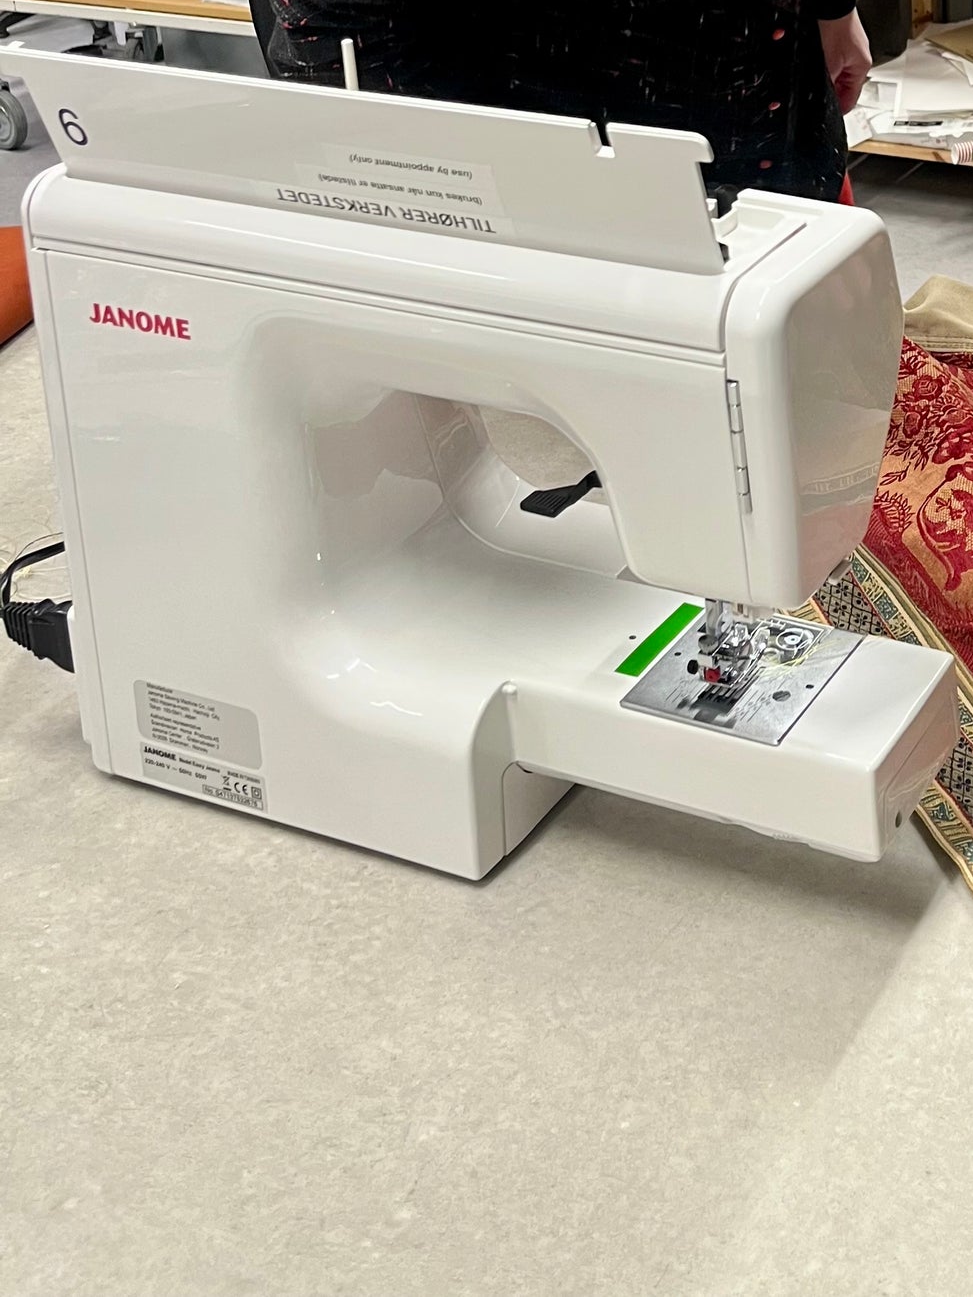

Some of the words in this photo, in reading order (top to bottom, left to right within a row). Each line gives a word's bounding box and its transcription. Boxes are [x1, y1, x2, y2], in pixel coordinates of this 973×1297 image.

[375, 158, 435, 173] appointment
[437, 166, 449, 176] by
[451, 170, 473, 181] (use
[277, 188, 396, 218] VERKSTEDET
[402, 207, 496, 234] TILHØRER
[89, 303, 191, 340] JANOME
